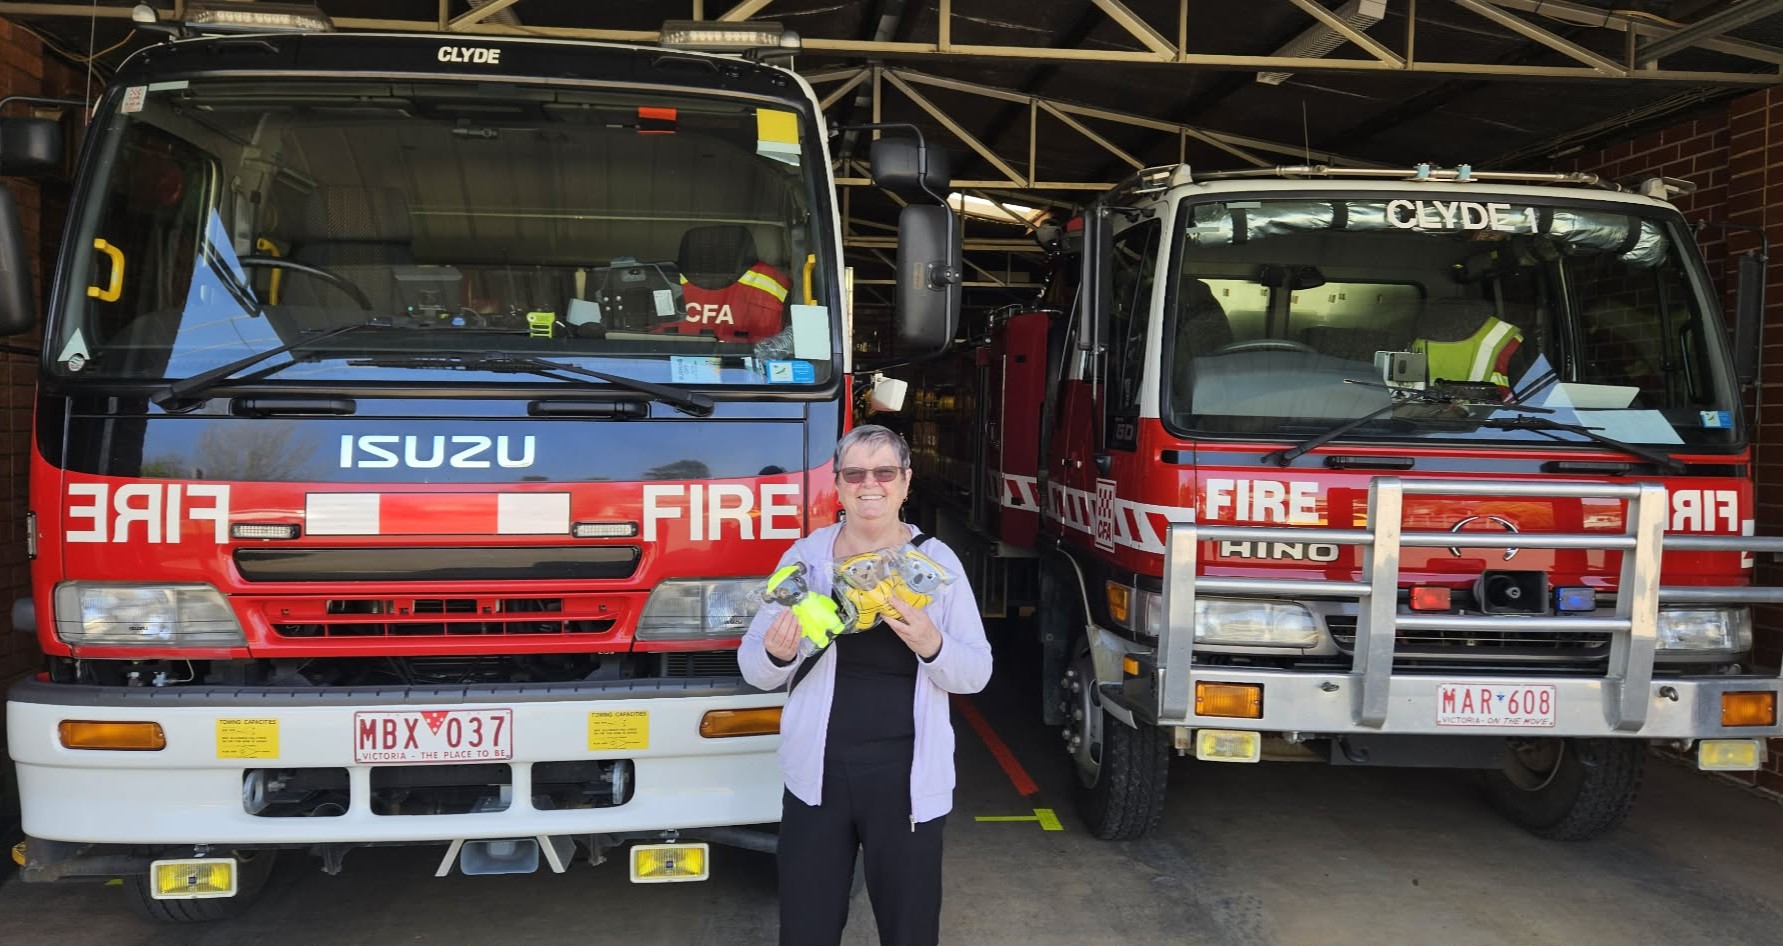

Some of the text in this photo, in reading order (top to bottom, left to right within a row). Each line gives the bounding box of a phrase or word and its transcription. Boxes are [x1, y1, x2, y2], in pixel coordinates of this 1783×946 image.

[437, 46, 501, 64] CLYDE
[1386, 199, 1539, 234] CLYDE 1
[685, 302, 734, 325] CFA
[340, 434, 536, 468] ISUZU
[642, 483, 801, 542] FIRE
[1205, 478, 1319, 524] FIRE
[1097, 520, 1112, 541] CFA
[1220, 540, 1340, 562] HINO
[1442, 688, 1550, 715] MAR 608
[359, 716, 505, 750] MBX 037
[1487, 717, 1500, 725] ON
[1504, 717, 1521, 725] THE
[1524, 718, 1549, 726] MOVE
[362, 752, 406, 760] VICTORIA
[421, 751, 438, 759] THE
[443, 750, 472, 759] PLACE
[477, 750, 489, 758] TO
[494, 749, 506, 757] BE
